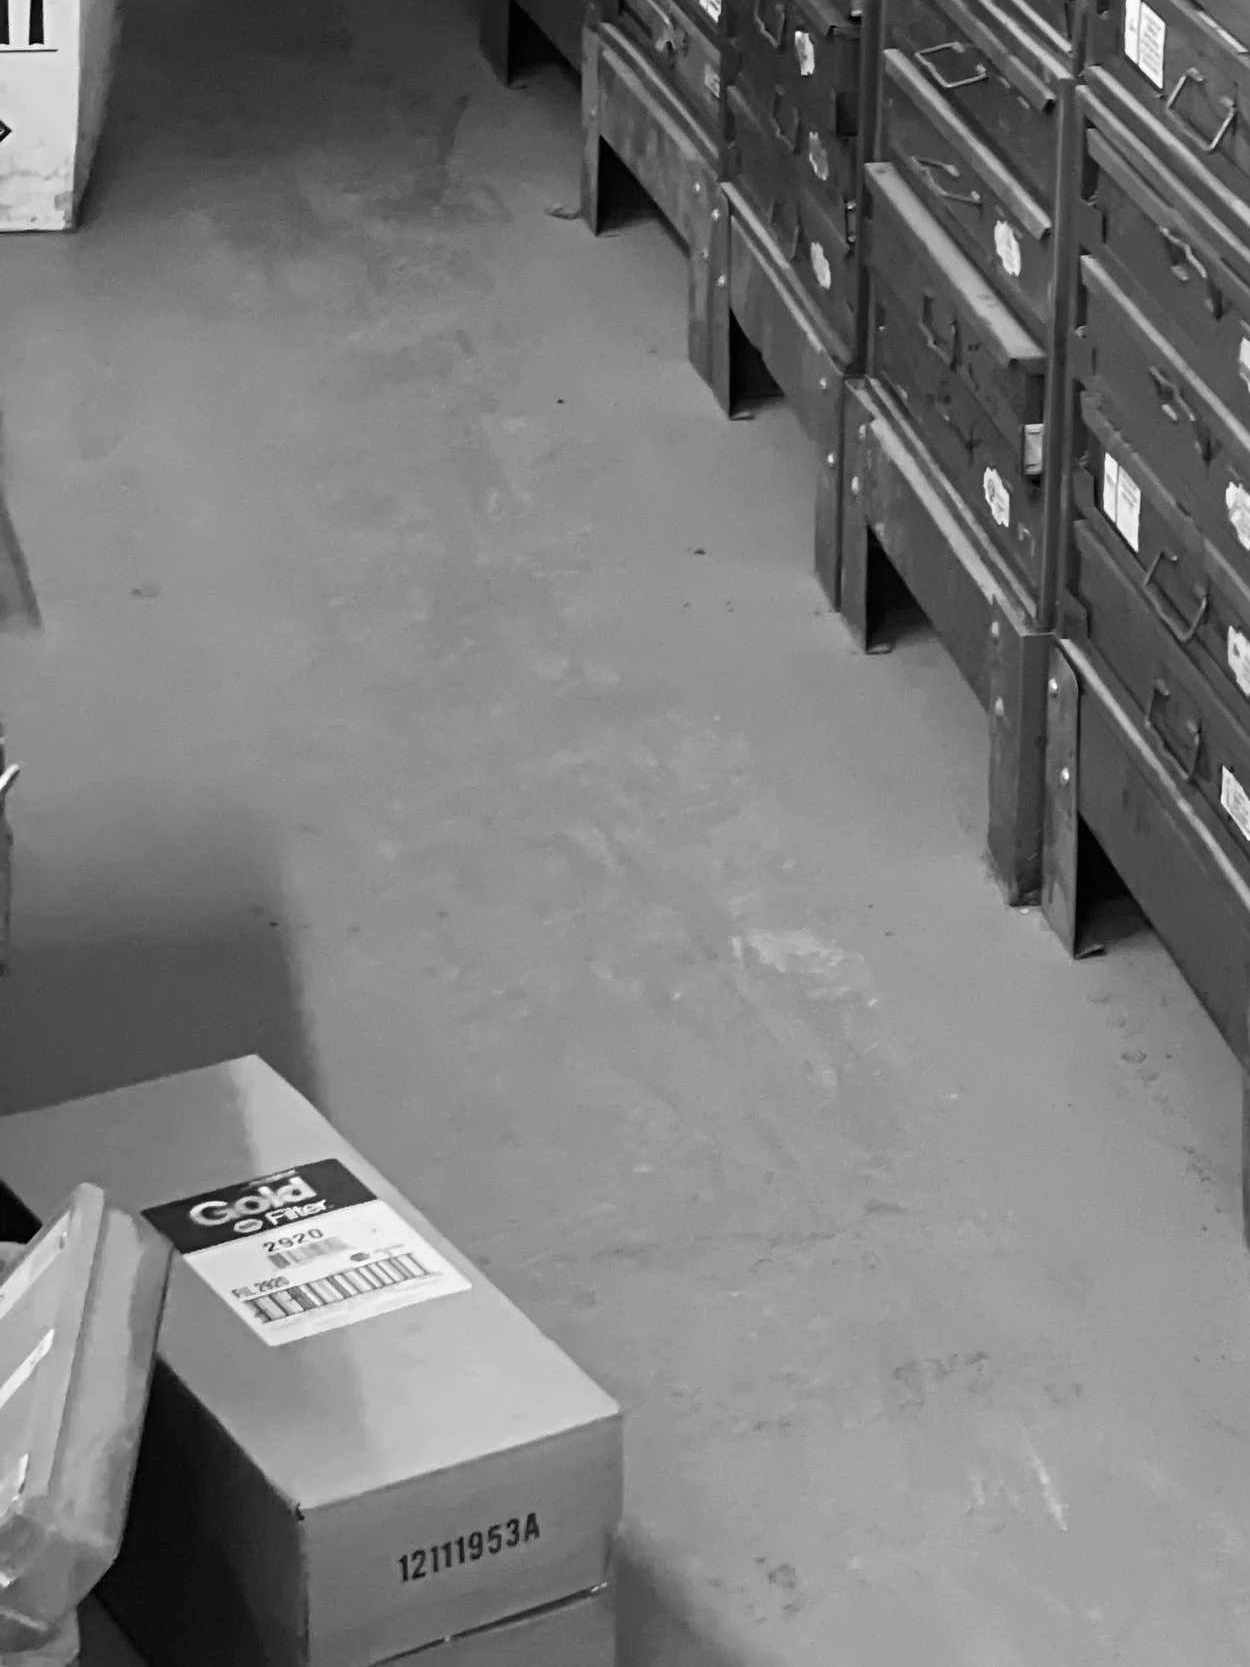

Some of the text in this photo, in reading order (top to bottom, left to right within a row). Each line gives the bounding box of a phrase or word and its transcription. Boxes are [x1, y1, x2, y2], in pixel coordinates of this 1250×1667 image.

[188, 1176, 318, 1227] Gold
[264, 1199, 328, 1227] Filter
[262, 1228, 325, 1254] 2920
[398, 1511, 541, 1584] 12111953A
